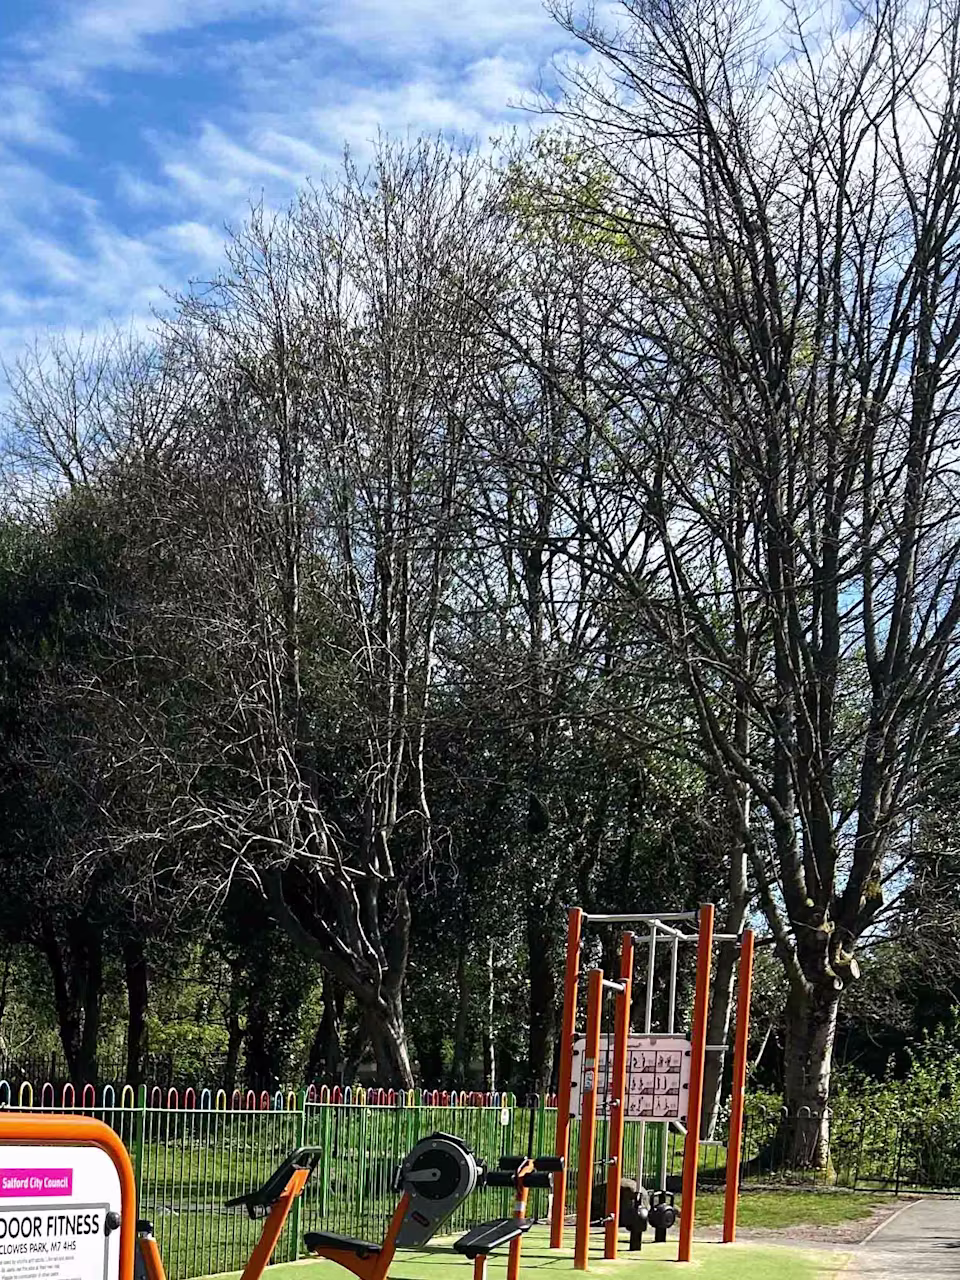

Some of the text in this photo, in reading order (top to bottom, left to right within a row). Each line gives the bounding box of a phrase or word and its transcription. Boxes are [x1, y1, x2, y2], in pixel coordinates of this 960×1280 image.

[2, 1176, 68, 1190] Salford City Council
[46, 1213, 99, 1236] FITNESS
[29, 1242, 49, 1254] PARK,
[50, 1241, 62, 1251] M7
[62, 1240, 76, 1250] 4HS
